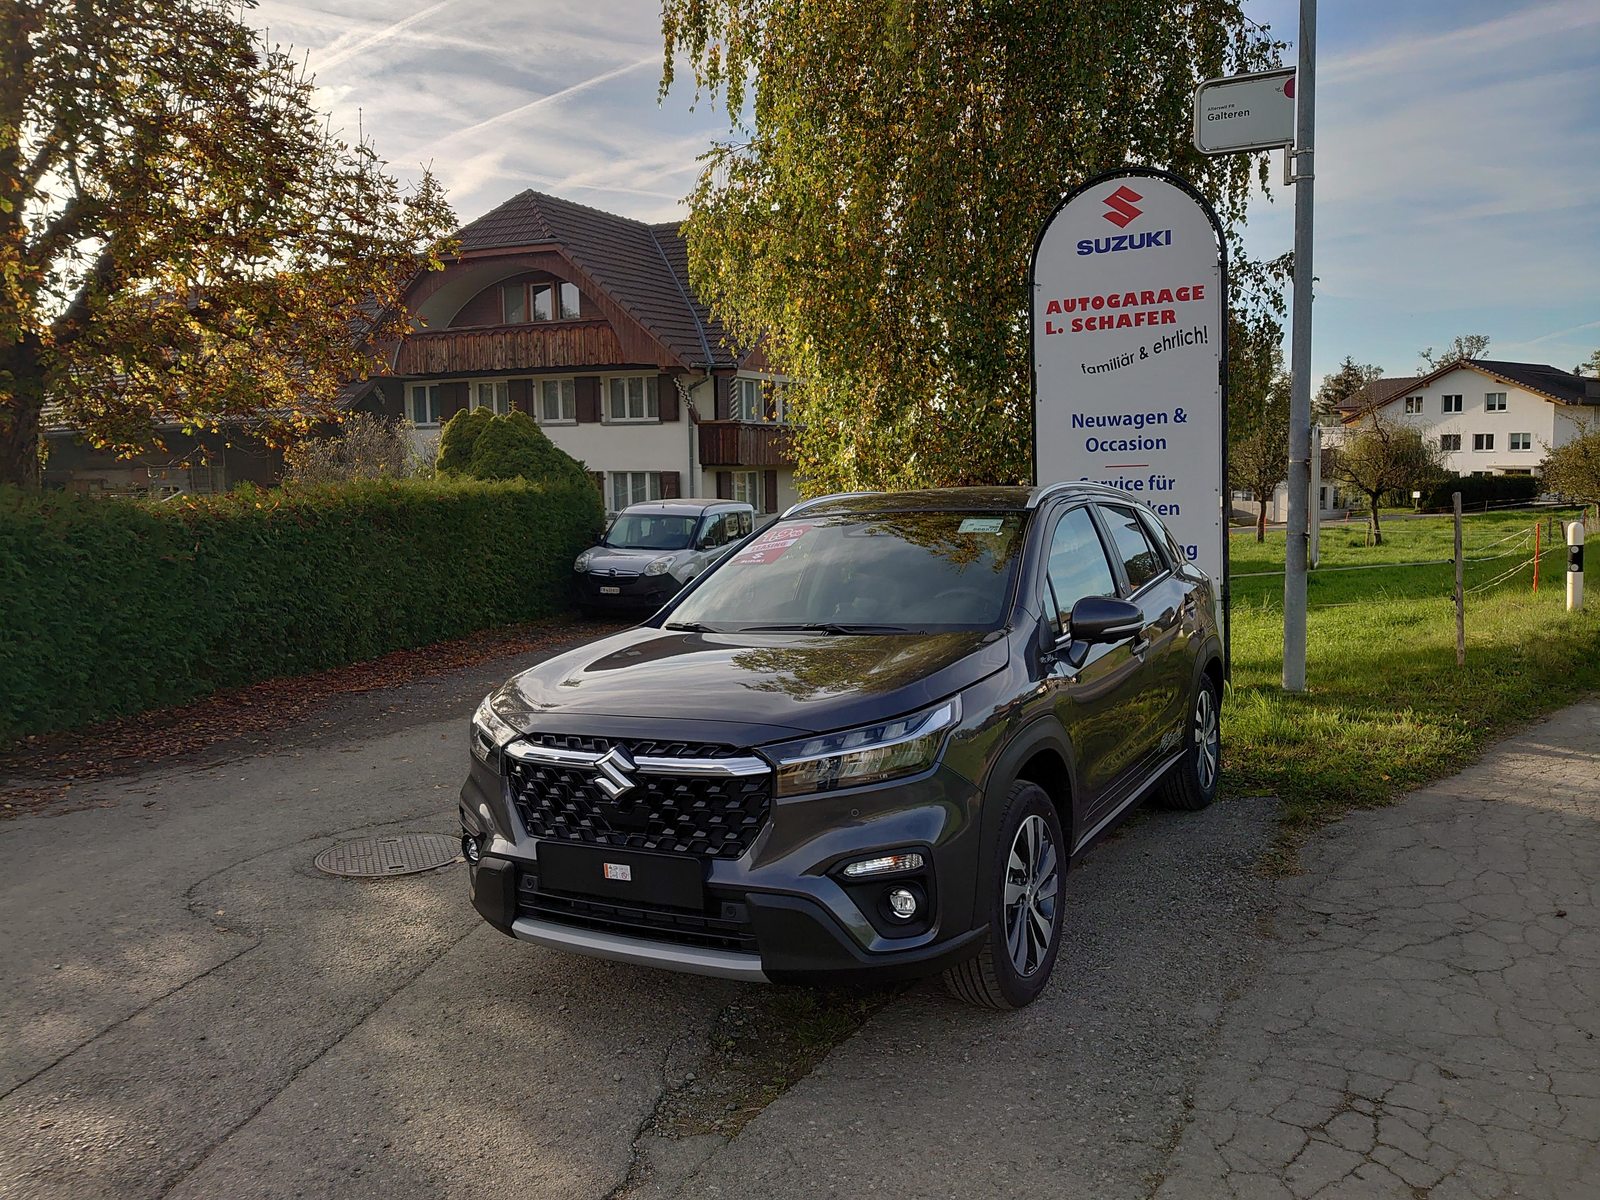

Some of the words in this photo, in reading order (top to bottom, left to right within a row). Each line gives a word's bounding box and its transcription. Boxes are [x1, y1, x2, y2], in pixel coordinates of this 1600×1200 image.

[1207, 109, 1250, 121] Galteren
[1076, 229, 1172, 256] SUZUKI
[1045, 285, 1205, 315] AUTOGARAGE
[1045, 321, 1064, 335] L.
[1071, 309, 1177, 333] SCHAFER
[1081, 352, 1135, 375] familiär
[1139, 346, 1149, 360] &
[1153, 325, 1208, 354] ehrlich!
[1071, 412, 1168, 430] Neuwagen
[1173, 407, 1188, 424] &
[1085, 435, 1167, 452] Occasion
[1079, 475, 1144, 491] vice
[1149, 475, 1175, 491] für
[751, 541, 787, 551] LEASING
